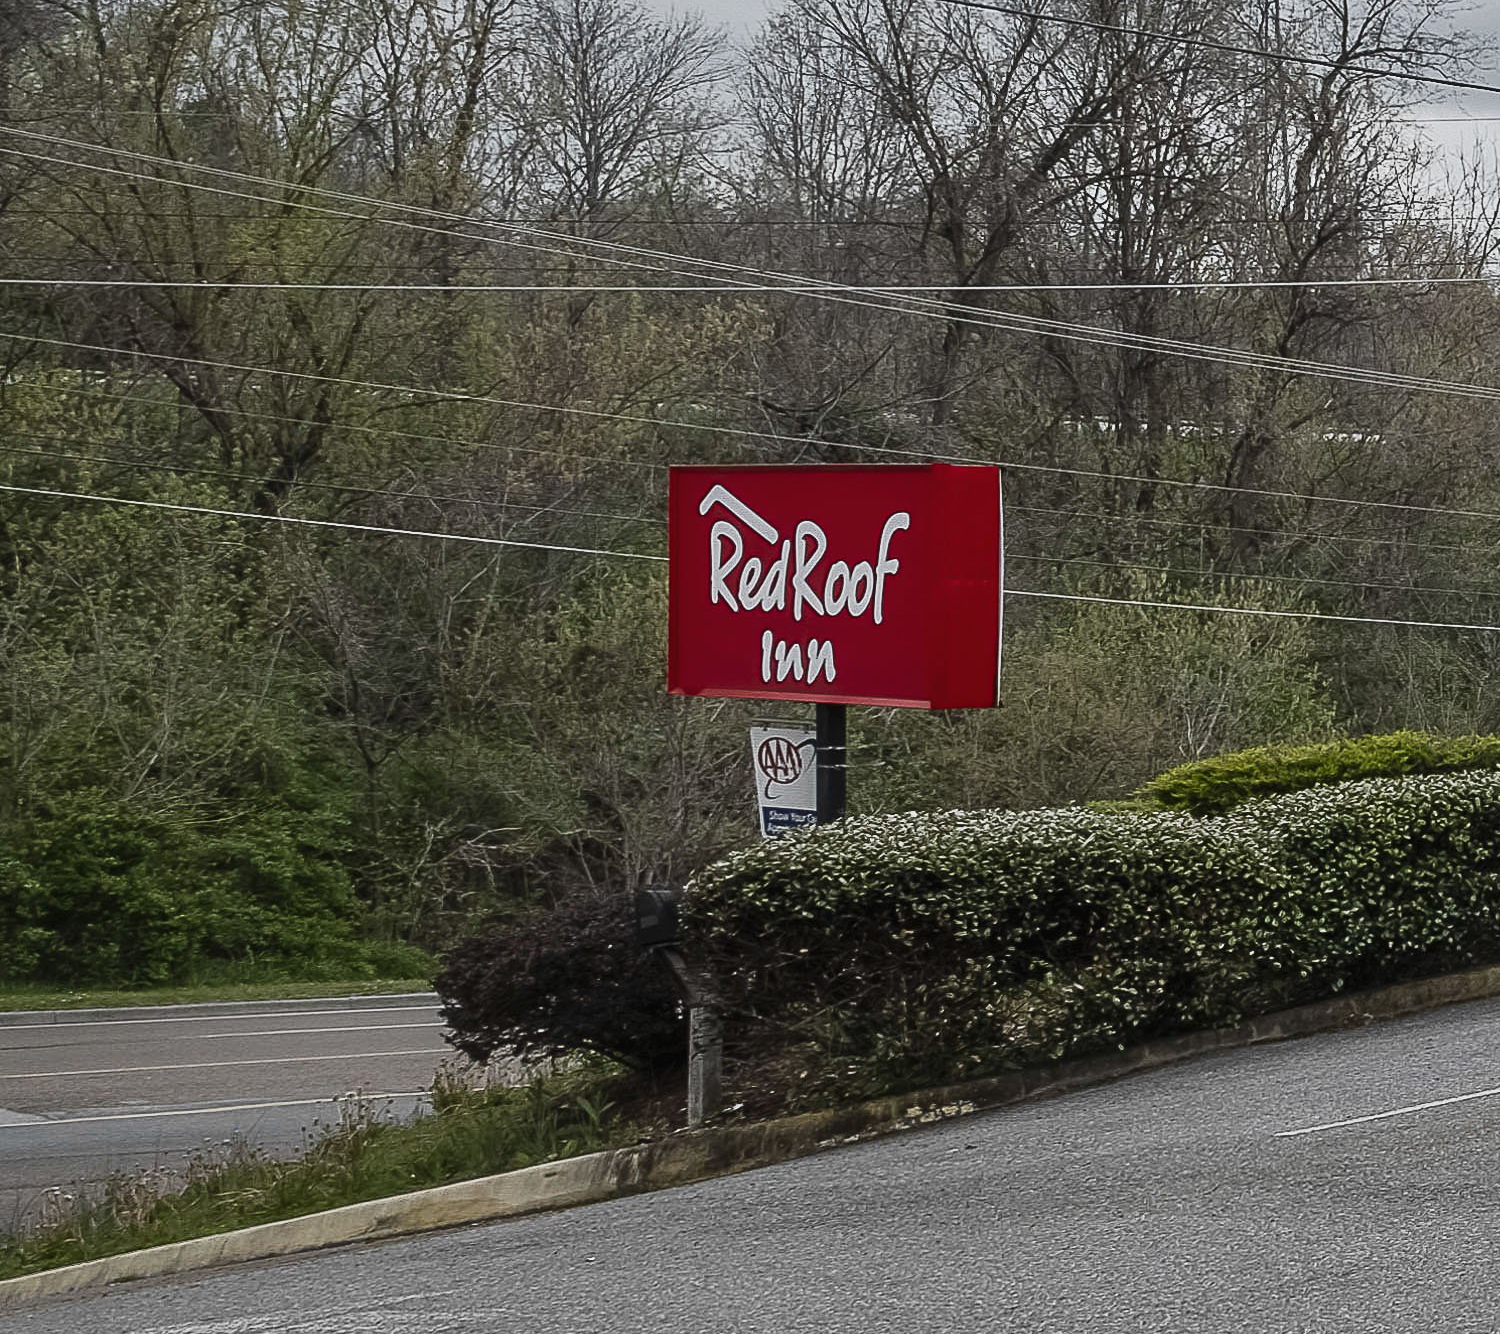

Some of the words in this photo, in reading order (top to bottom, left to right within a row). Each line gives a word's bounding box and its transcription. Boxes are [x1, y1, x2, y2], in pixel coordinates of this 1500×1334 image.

[710, 520, 791, 613] Red
[792, 512, 911, 625] Roof
[762, 630, 837, 685] Inn
[763, 738, 800, 779] AAA
